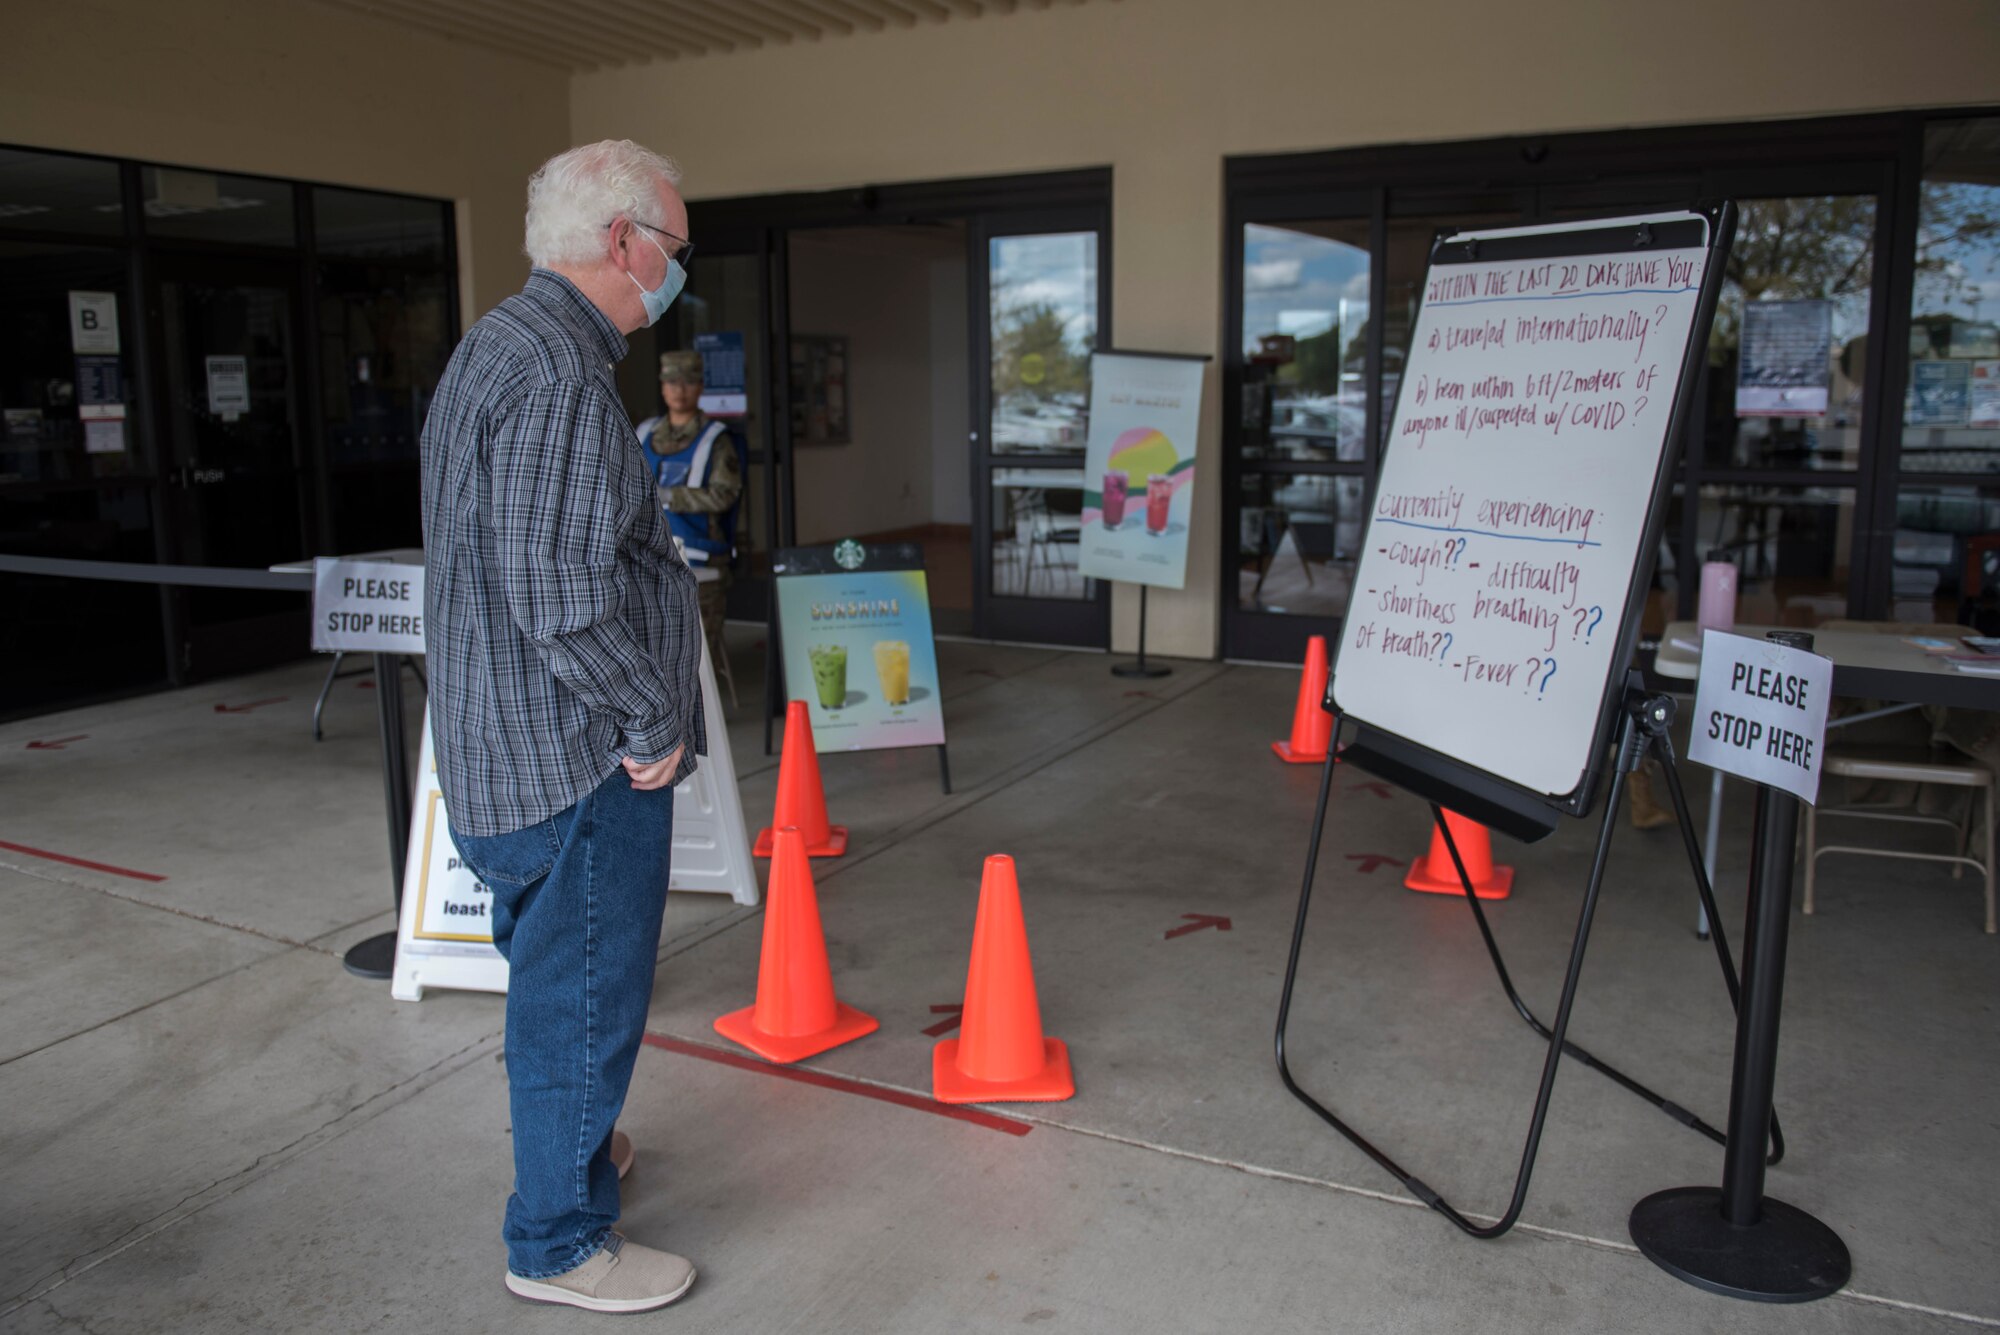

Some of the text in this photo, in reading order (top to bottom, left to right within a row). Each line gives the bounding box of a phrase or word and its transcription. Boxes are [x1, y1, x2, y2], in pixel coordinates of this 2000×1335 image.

[1429, 273, 1477, 302] WITHIN
[1484, 270, 1512, 296] THE
[1517, 264, 1556, 293] LAST
[1558, 265, 1579, 291] 20
[1586, 260, 1623, 288] DAYS
[1625, 257, 1663, 288] HAVE
[81, 309, 98, 331] B
[1428, 328, 1441, 353] a)
[1446, 318, 1507, 351] traveled
[1416, 374, 1428, 406] b)
[1435, 377, 1464, 400] been
[1471, 375, 1514, 400] within
[1636, 364, 1659, 392] of
[1403, 413, 1449, 449] anyone
[1545, 402, 1568, 435] w/
[194, 470, 225, 483] PUSH
[343, 577, 410, 601] PLEASE
[1488, 561, 1581, 609] difficulty
[328, 612, 422, 636] STOP HERE
[811, 599, 900, 620] SUNSHINE
[1473, 590, 1559, 652] breathing
[1731, 661, 1809, 711] PLEASE
[1708, 710, 1813, 771] STOP HERE
[443, 900, 486, 917] least
